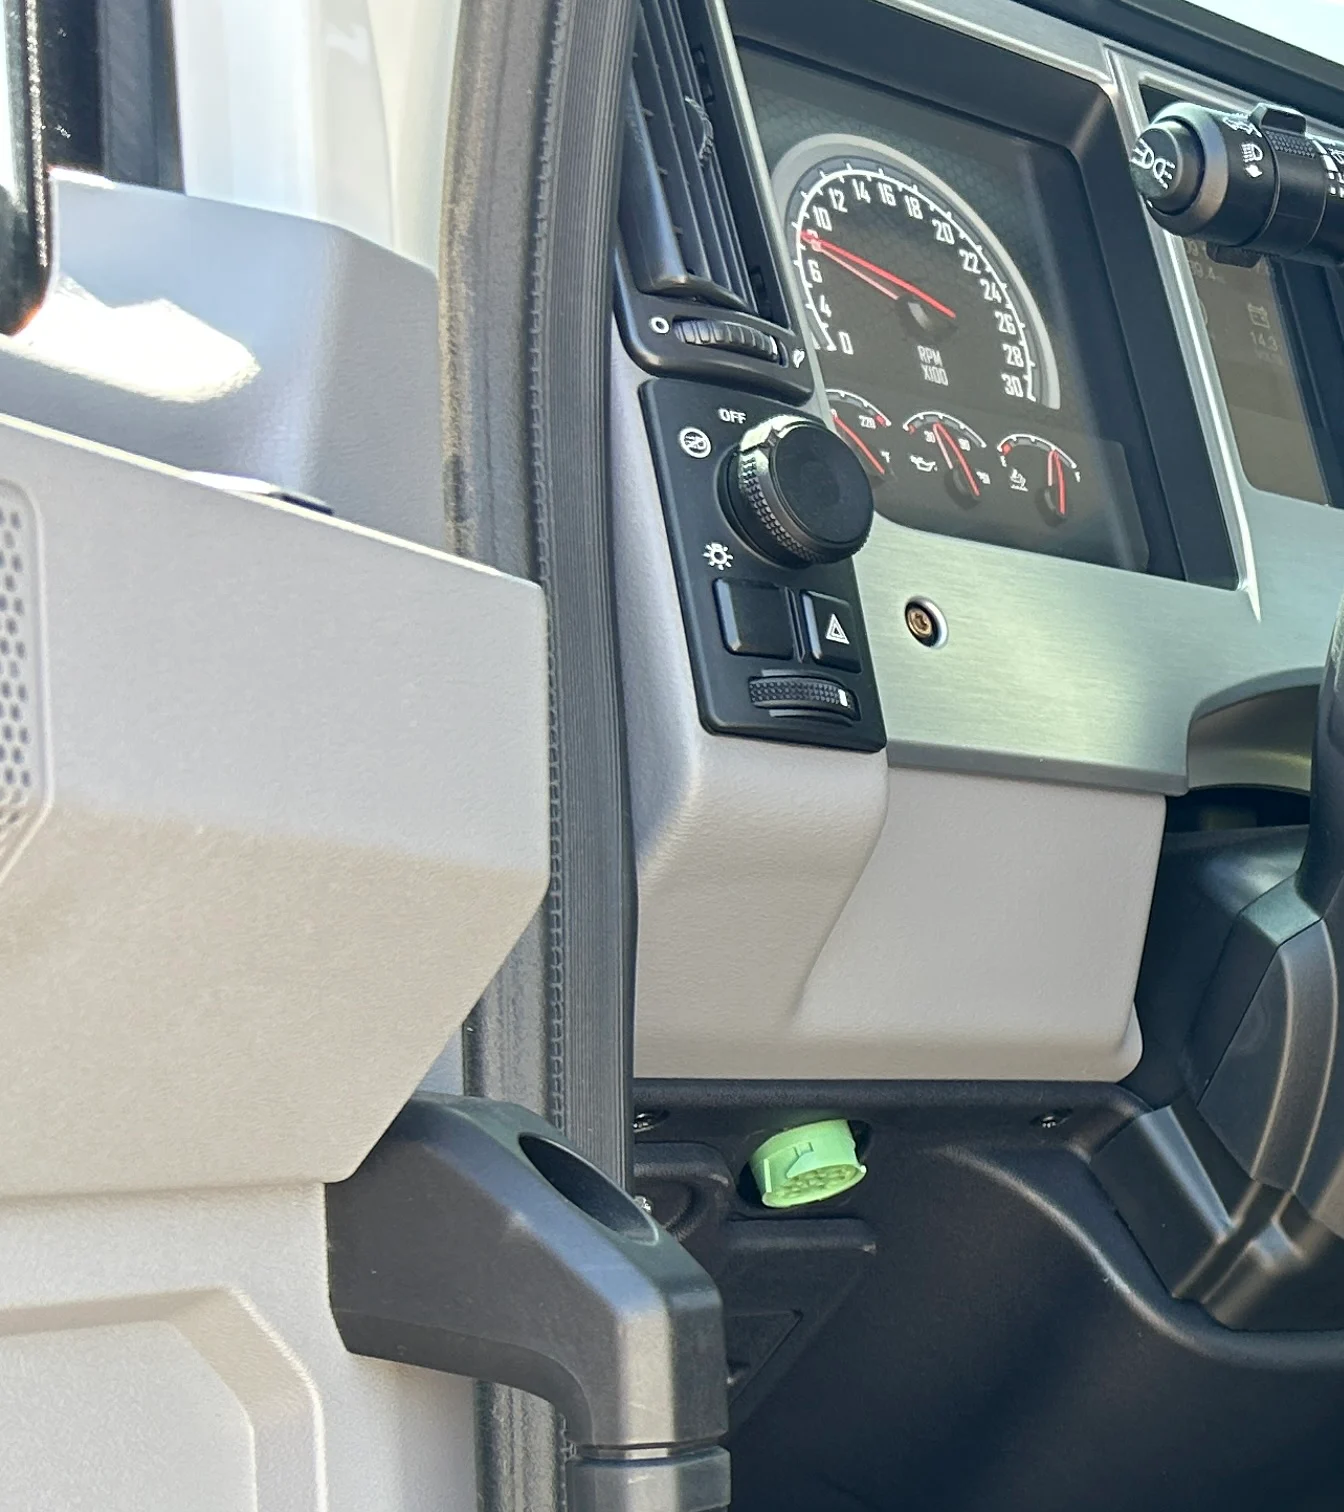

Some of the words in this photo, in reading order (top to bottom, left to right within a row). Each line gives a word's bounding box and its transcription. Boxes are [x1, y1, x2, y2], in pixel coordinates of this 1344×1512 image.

[829, 187, 847, 213] 12
[852, 179, 870, 203] 14
[877, 182, 896, 206] 16
[813, 206, 832, 231] 10
[904, 195, 923, 219] 18
[932, 219, 956, 245] 20
[808, 260, 823, 283] 6
[959, 249, 982, 274] 22
[981, 279, 1002, 303] 24
[820, 295, 832, 318] 4
[995, 310, 1016, 335] 26
[838, 331, 854, 355] 0
[1002, 343, 1025, 367] 28
[917, 345, 943, 366] RPM
[920, 363, 949, 386] X100
[1001, 372, 1024, 398] 30
[718, 407, 747, 425] OFF
